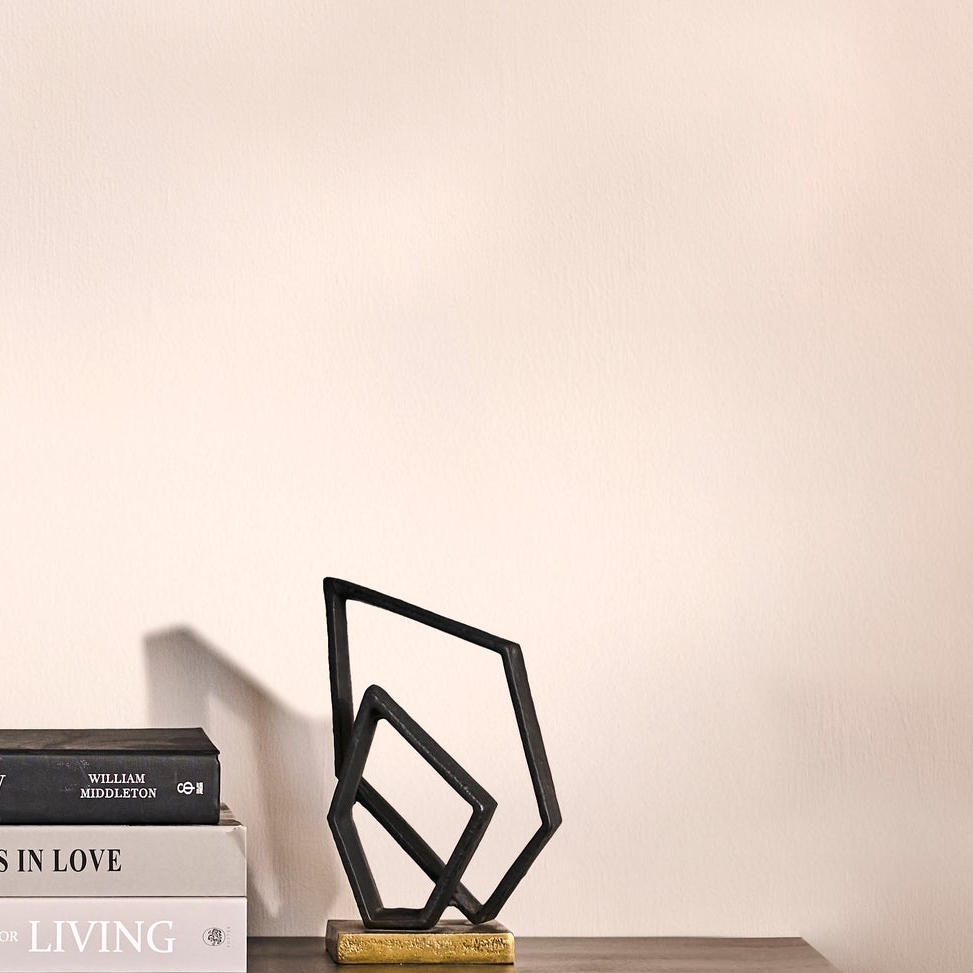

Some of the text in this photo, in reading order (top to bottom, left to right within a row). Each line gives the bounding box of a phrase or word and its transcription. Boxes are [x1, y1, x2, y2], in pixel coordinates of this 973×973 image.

[88, 773, 146, 784] WILLIAM
[80, 788, 157, 799] MIDDLETON
[16, 848, 44, 873] IN
[53, 848, 122, 873] LOVE
[28, 919, 176, 954] LIVING
